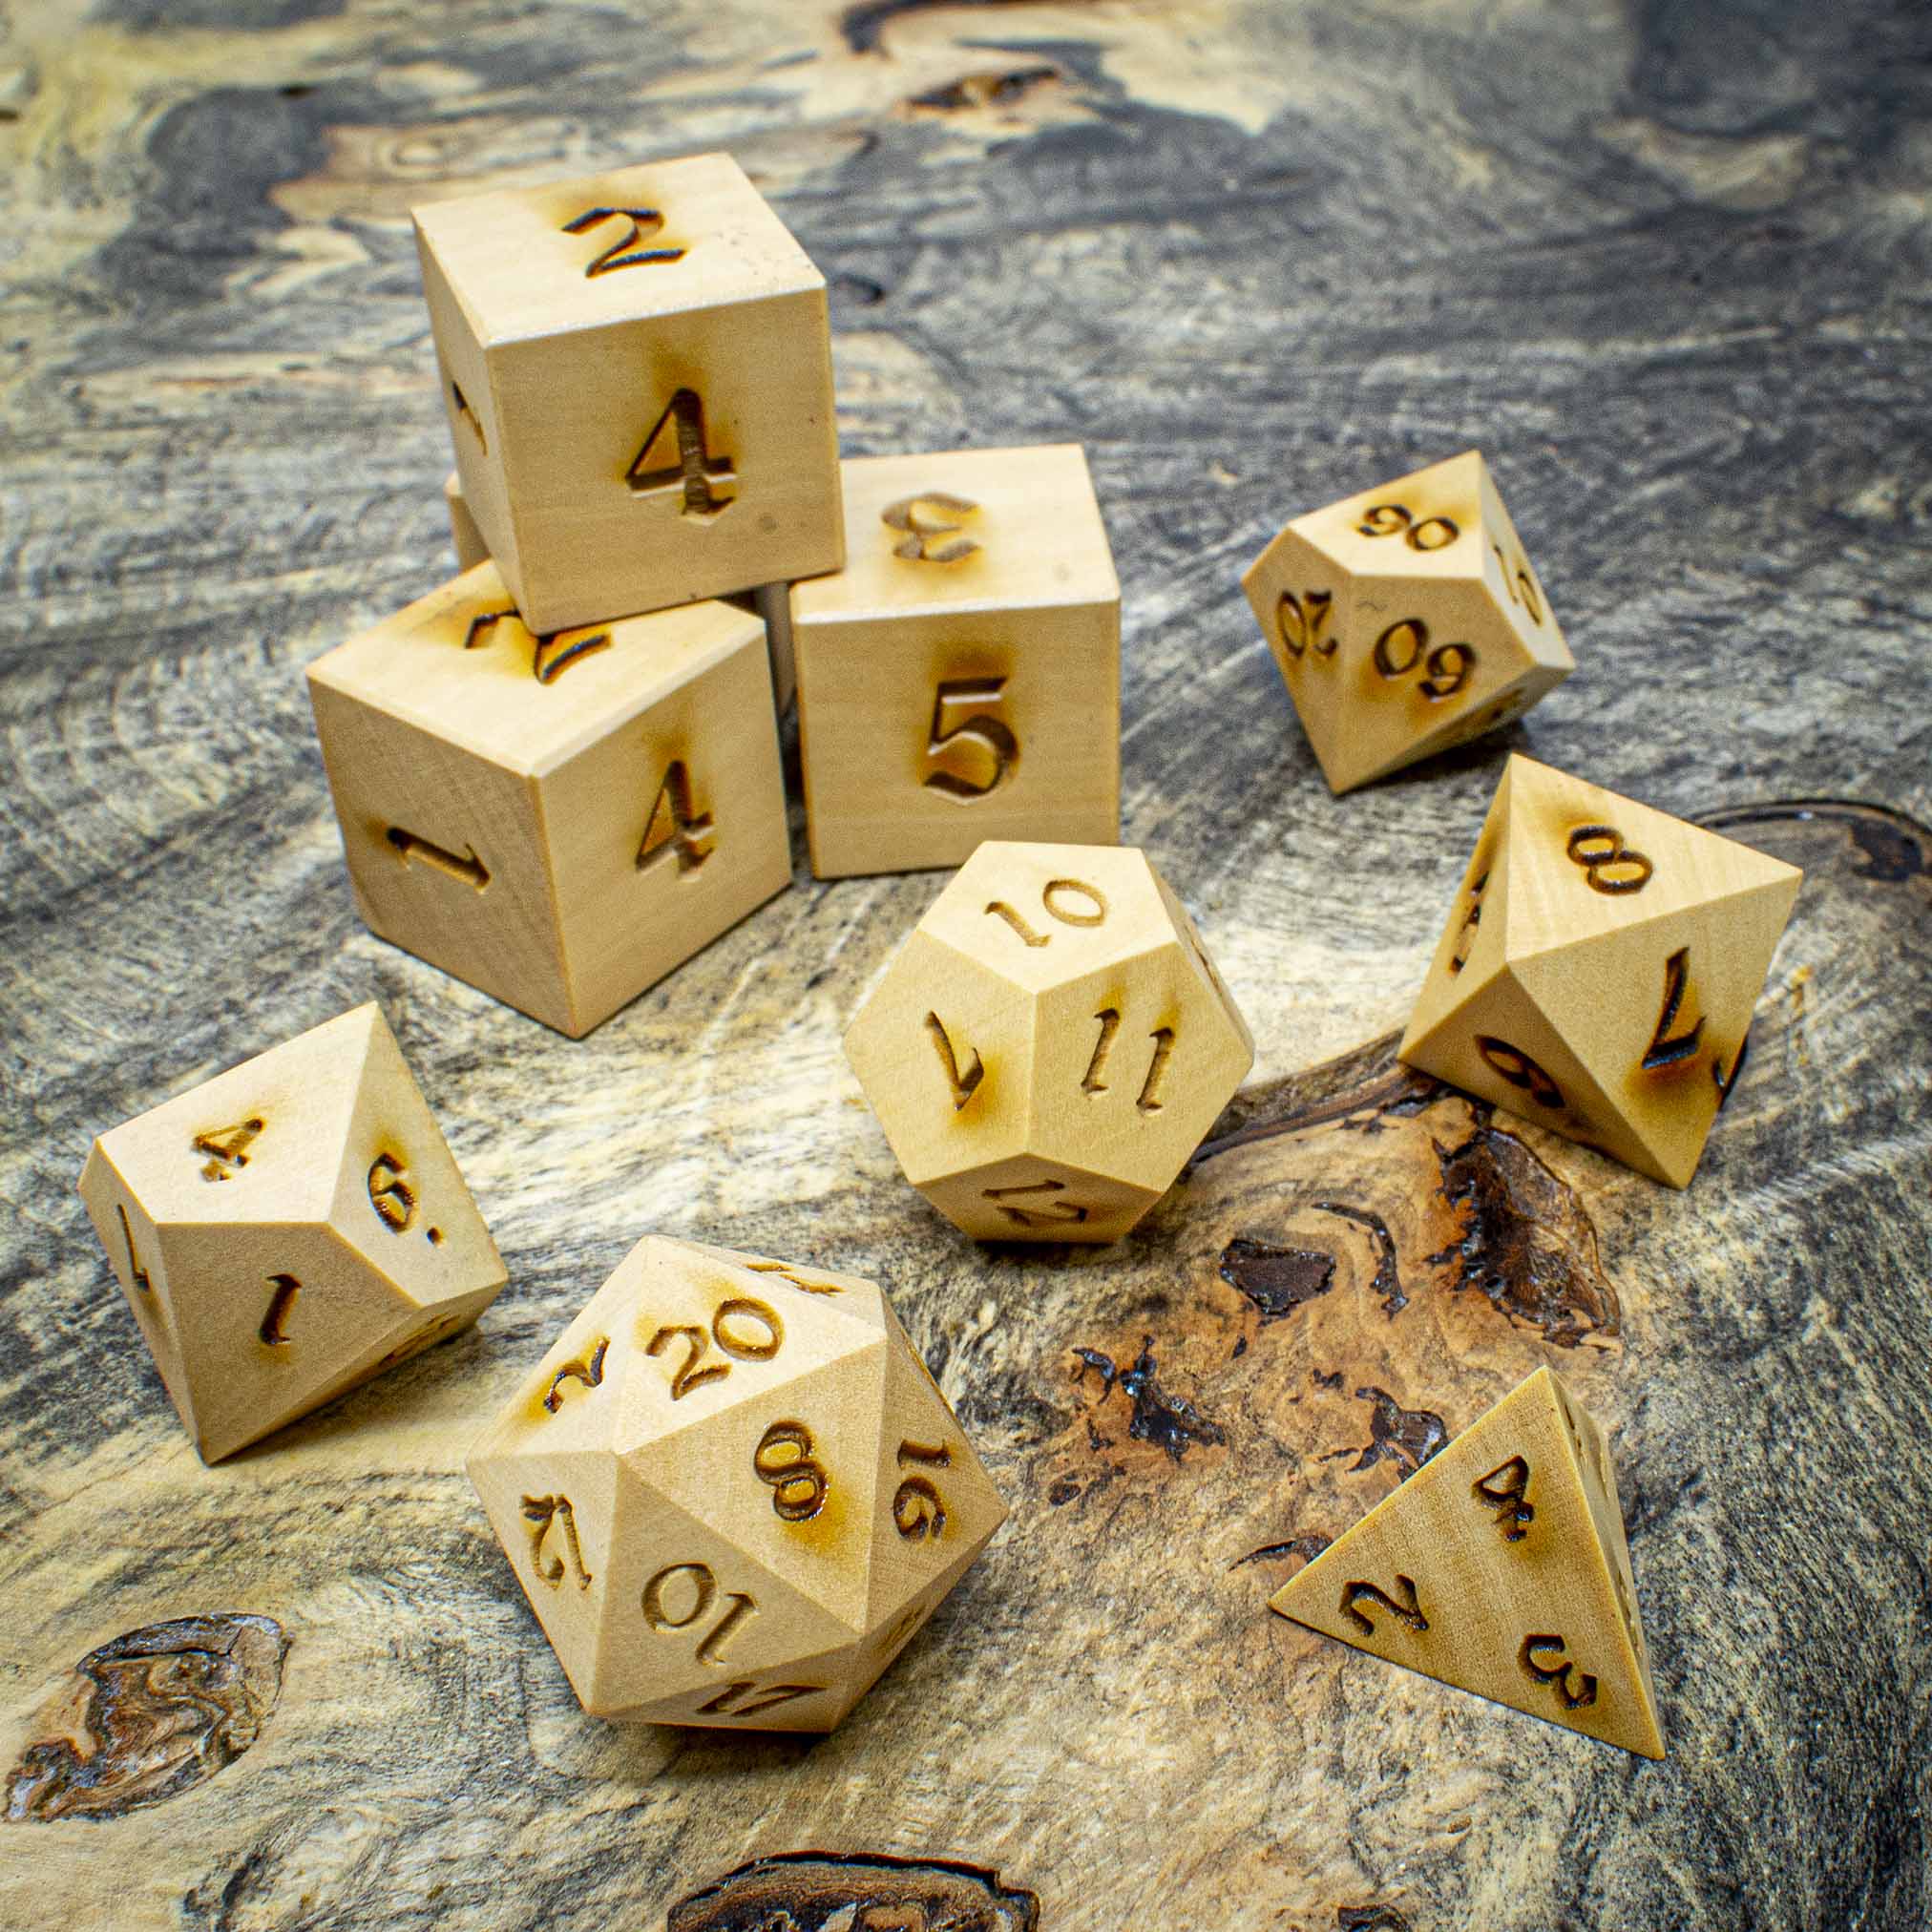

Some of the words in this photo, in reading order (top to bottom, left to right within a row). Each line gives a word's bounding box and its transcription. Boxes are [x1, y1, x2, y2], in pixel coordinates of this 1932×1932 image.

[559, 205, 687, 279] 2
[624, 387, 739, 527] 4
[1356, 503, 1460, 553] 90
[923, 675, 1019, 806] 5
[636, 760, 714, 882] 4
[386, 826, 490, 893] 1
[1566, 824, 1653, 896] 8
[983, 877, 1107, 949] 10
[1080, 1006, 1177, 1119] 11
[194, 1117, 266, 1183] 4
[258, 1273, 304, 1346] 1
[645, 1297, 786, 1401] 20
[754, 1419, 829, 1522] 8
[1470, 1454, 1535, 1544] 4
[1338, 1573, 1432, 1638] 2
[1518, 1633, 1598, 1712] 3
